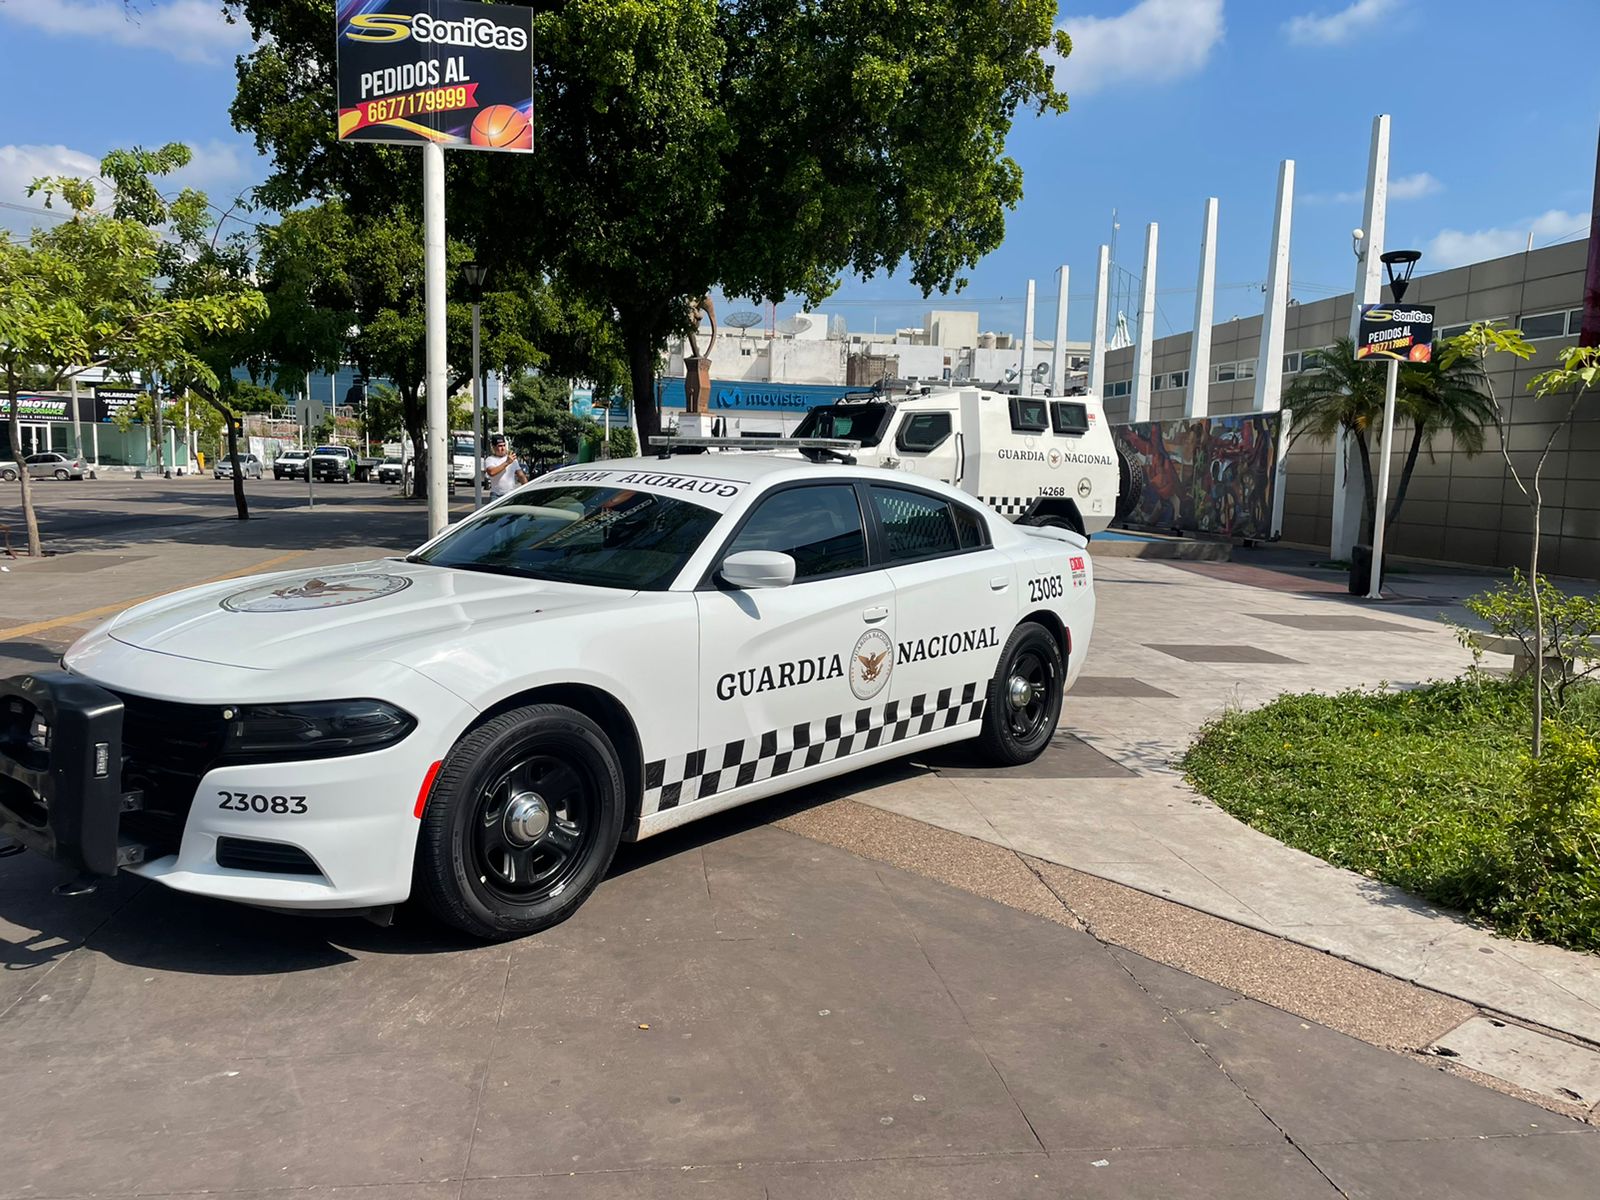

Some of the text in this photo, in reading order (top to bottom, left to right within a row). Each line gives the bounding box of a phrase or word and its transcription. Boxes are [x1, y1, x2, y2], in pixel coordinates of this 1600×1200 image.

[411, 13, 527, 51] SoniGas
[361, 56, 470, 98] PEDIDOS AL
[367, 87, 466, 122] 6677179999
[1392, 309, 1433, 323] SoniGas
[1368, 325, 1412, 343] PEDIDOS AL
[747, 392, 808, 407] movistar
[998, 449, 1112, 465] GUARDIA NACIONAL
[1038, 486, 1065, 496] 14268
[1028, 575, 1063, 602] 23083
[716, 626, 1000, 701] GUARDIA NACIONAL
[217, 791, 308, 814] 23083
